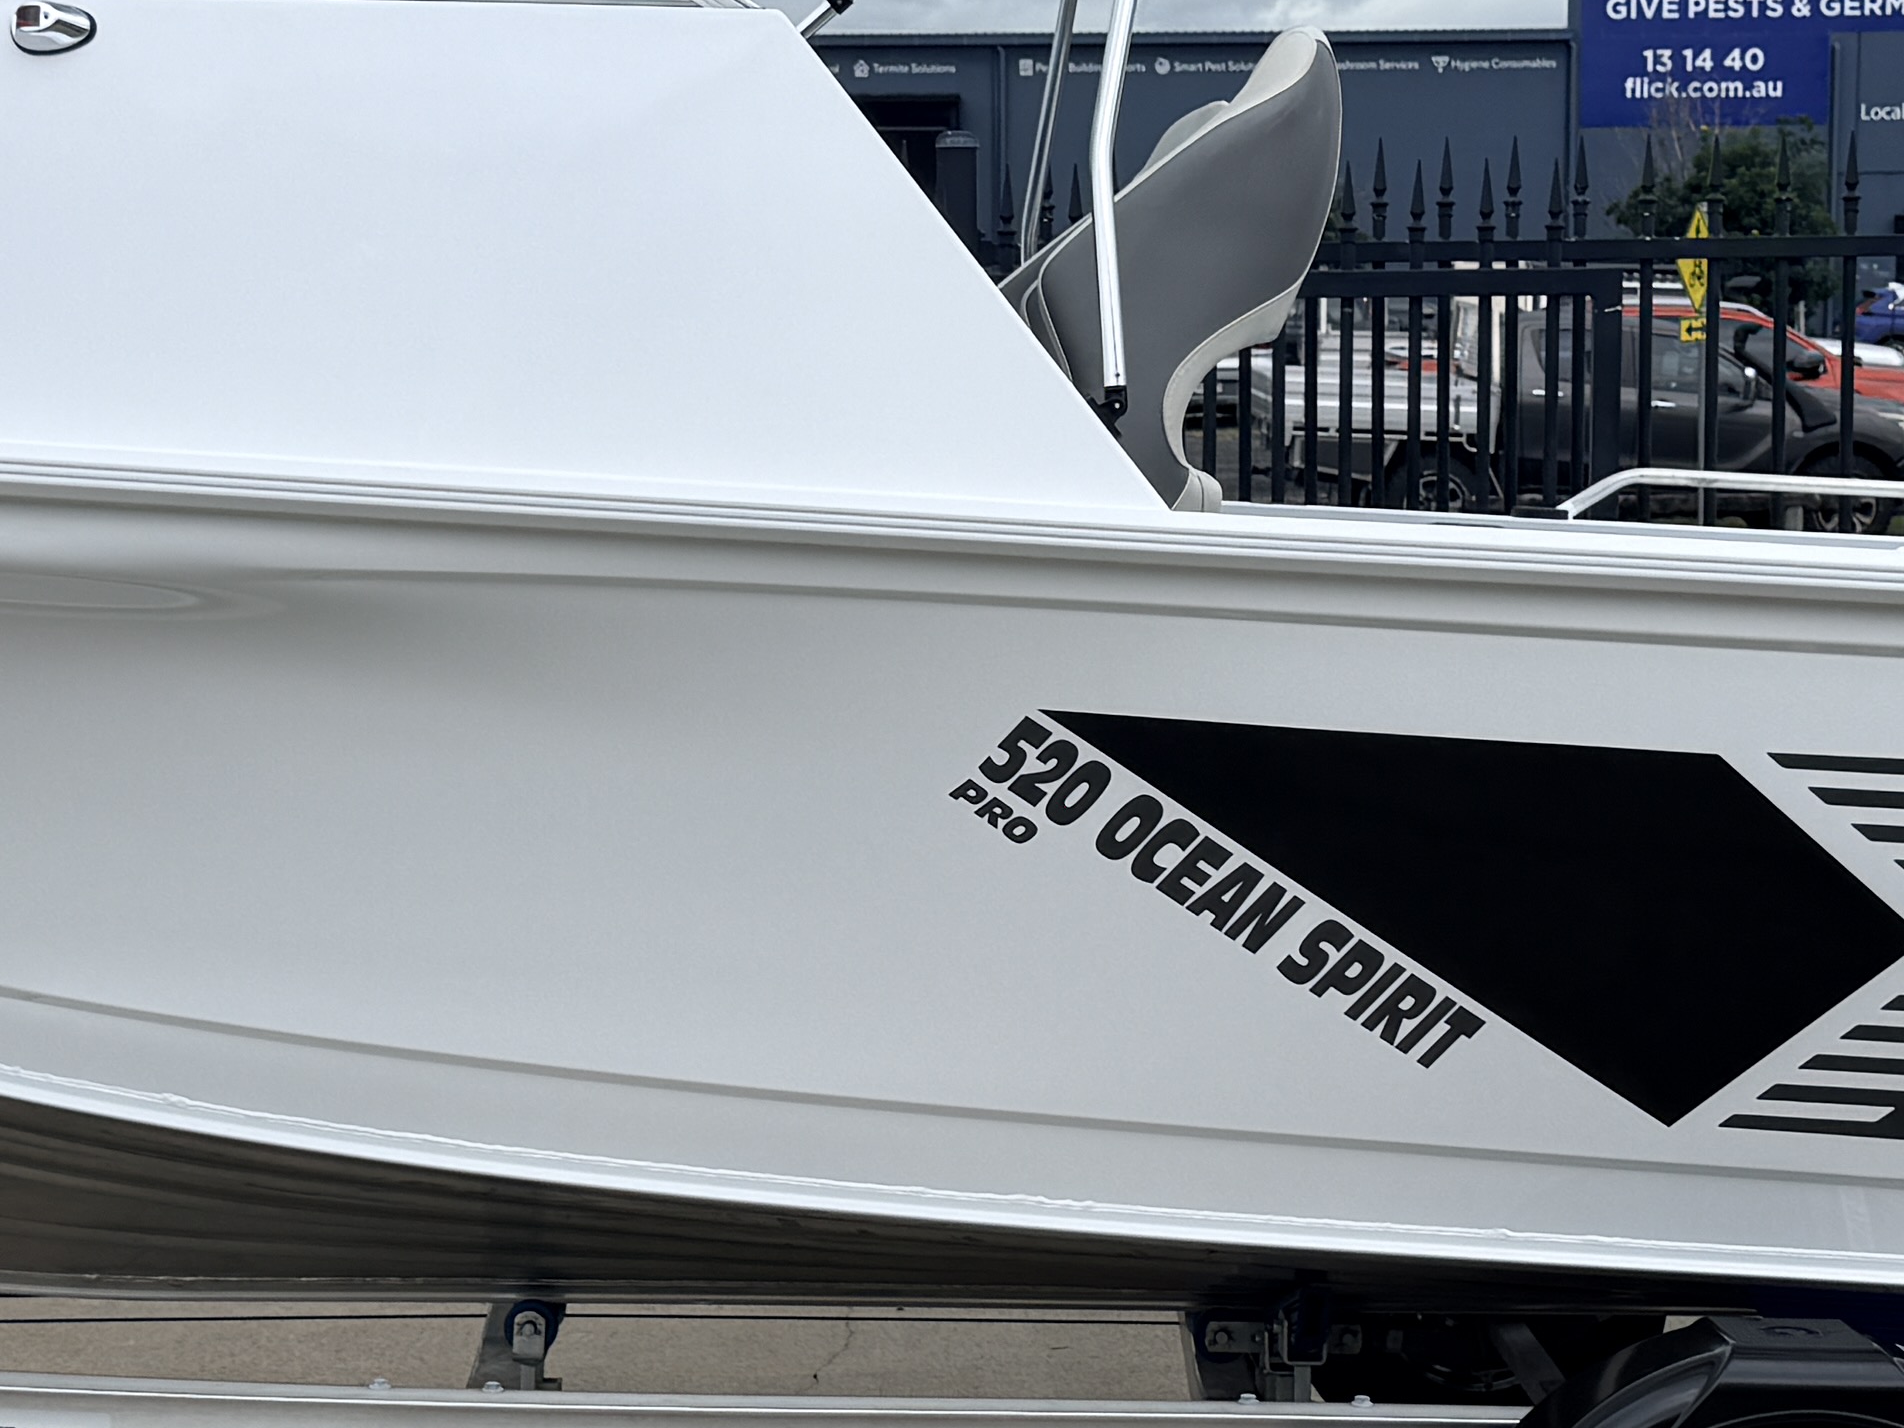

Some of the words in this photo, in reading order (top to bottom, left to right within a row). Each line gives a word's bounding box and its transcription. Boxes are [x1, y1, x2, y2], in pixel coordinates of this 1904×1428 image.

[911, 62, 956, 74] Solutions
[1379, 58, 1419, 70] Services
[1450, 58, 1489, 71] Hygiene
[1491, 57, 1557, 69] Consumables
[1642, 47, 1673, 73] 13
[1681, 47, 1714, 73] 14
[1723, 47, 1765, 72] 40
[1623, 75, 1784, 100] flick.com.au
[947, 778, 1039, 845] PRO
[977, 714, 1112, 827] 520
[1095, 792, 1306, 954] OCEAN
[1276, 918, 1487, 1070] SPIRIT
